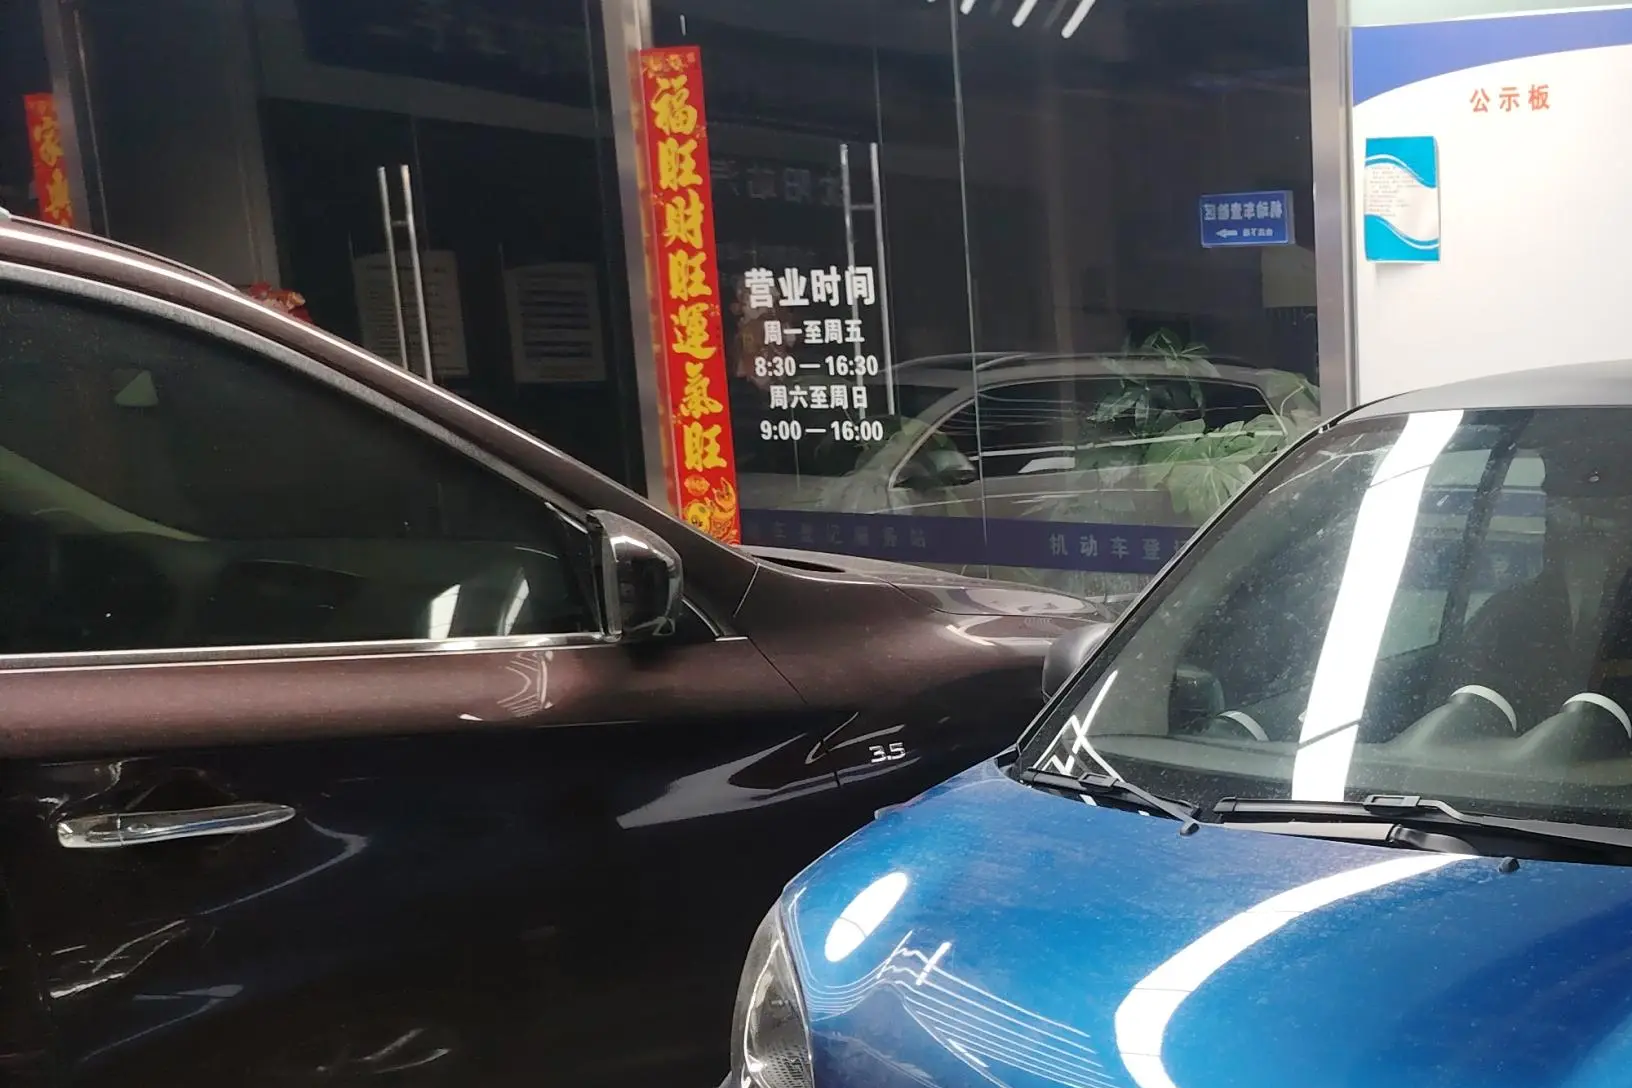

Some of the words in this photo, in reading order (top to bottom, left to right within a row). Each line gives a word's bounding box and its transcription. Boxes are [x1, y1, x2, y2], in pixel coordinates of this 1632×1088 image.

[1469, 83, 1551, 113] 公示板
[744, 265, 876, 309] 营业时间
[764, 319, 865, 345] 周一至周五
[770, 385, 868, 409] 周六至周日
[868, 741, 907, 763] 3.5
